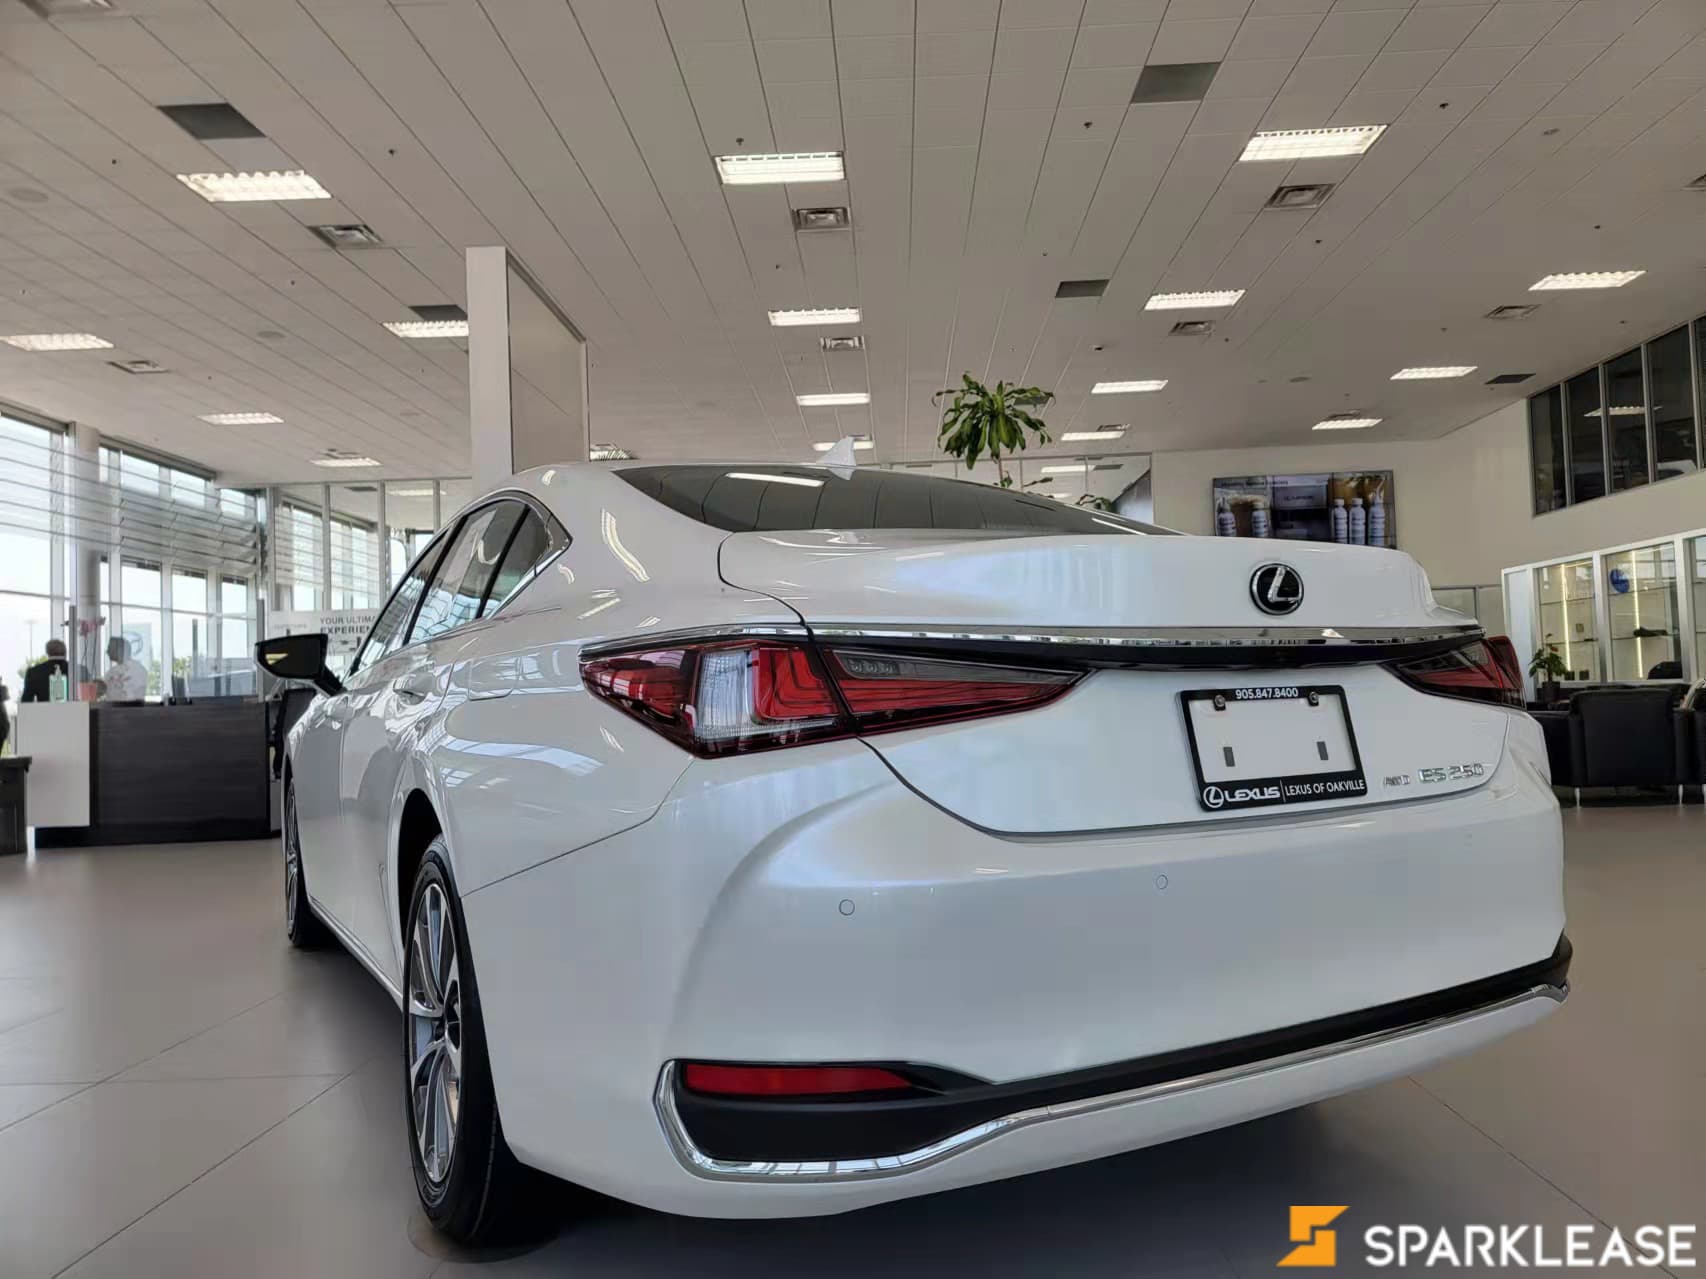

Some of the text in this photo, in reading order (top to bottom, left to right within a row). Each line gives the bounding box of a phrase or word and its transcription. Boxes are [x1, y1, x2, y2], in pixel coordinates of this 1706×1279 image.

[320, 616, 344, 624] YOUR
[1235, 687, 1298, 700] 905.847.8400
[1418, 767, 1447, 783] ES
[1448, 763, 1484, 780] 250
[1224, 786, 1281, 802] LEXUS
[1285, 783, 1312, 796] LEXUS
[1313, 782, 1326, 793] OF
[1326, 779, 1365, 793] OAKVILLE
